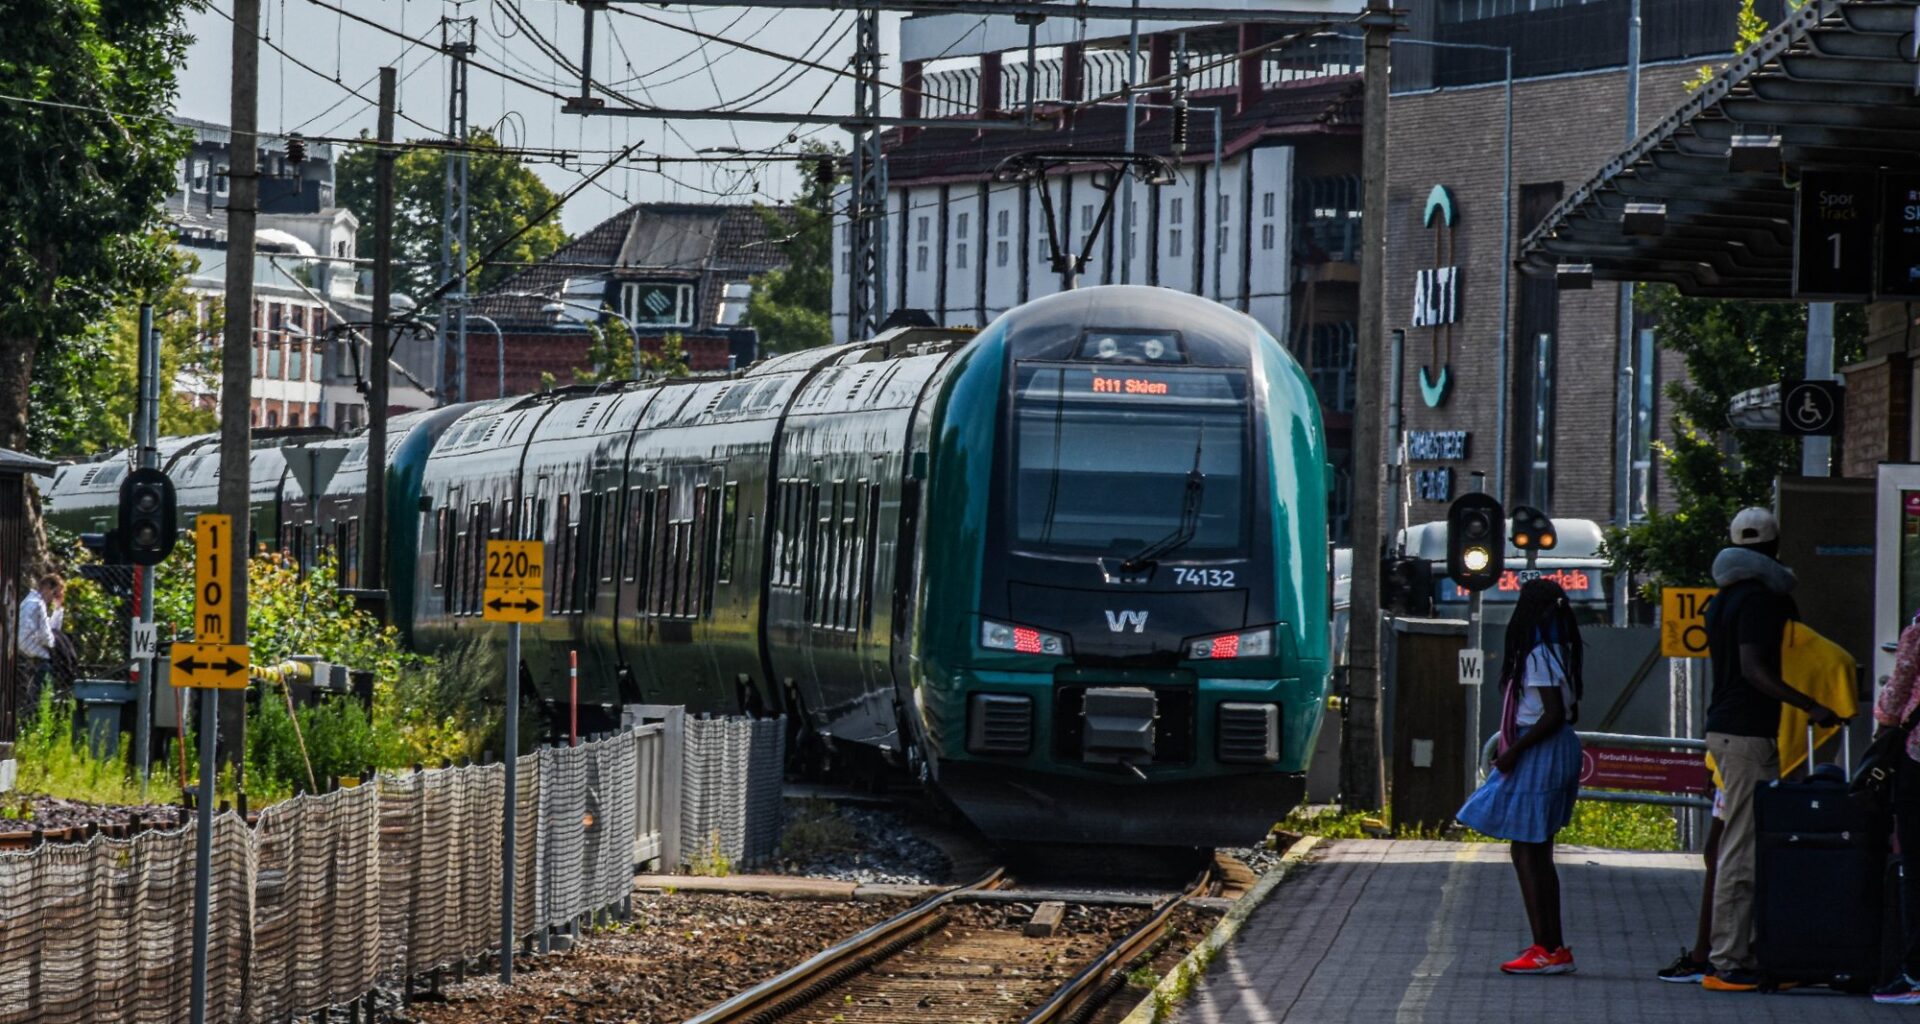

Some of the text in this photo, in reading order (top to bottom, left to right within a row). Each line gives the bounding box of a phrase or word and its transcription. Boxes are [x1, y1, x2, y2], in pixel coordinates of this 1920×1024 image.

[1819, 190, 1854, 206] Spor
[1819, 206, 1858, 219] Track
[1827, 232, 1841, 269] 1
[1412, 266, 1457, 327] ALTI
[1093, 377, 1121, 392] R11
[489, 551, 541, 578] 220m
[1173, 567, 1235, 587] 74132
